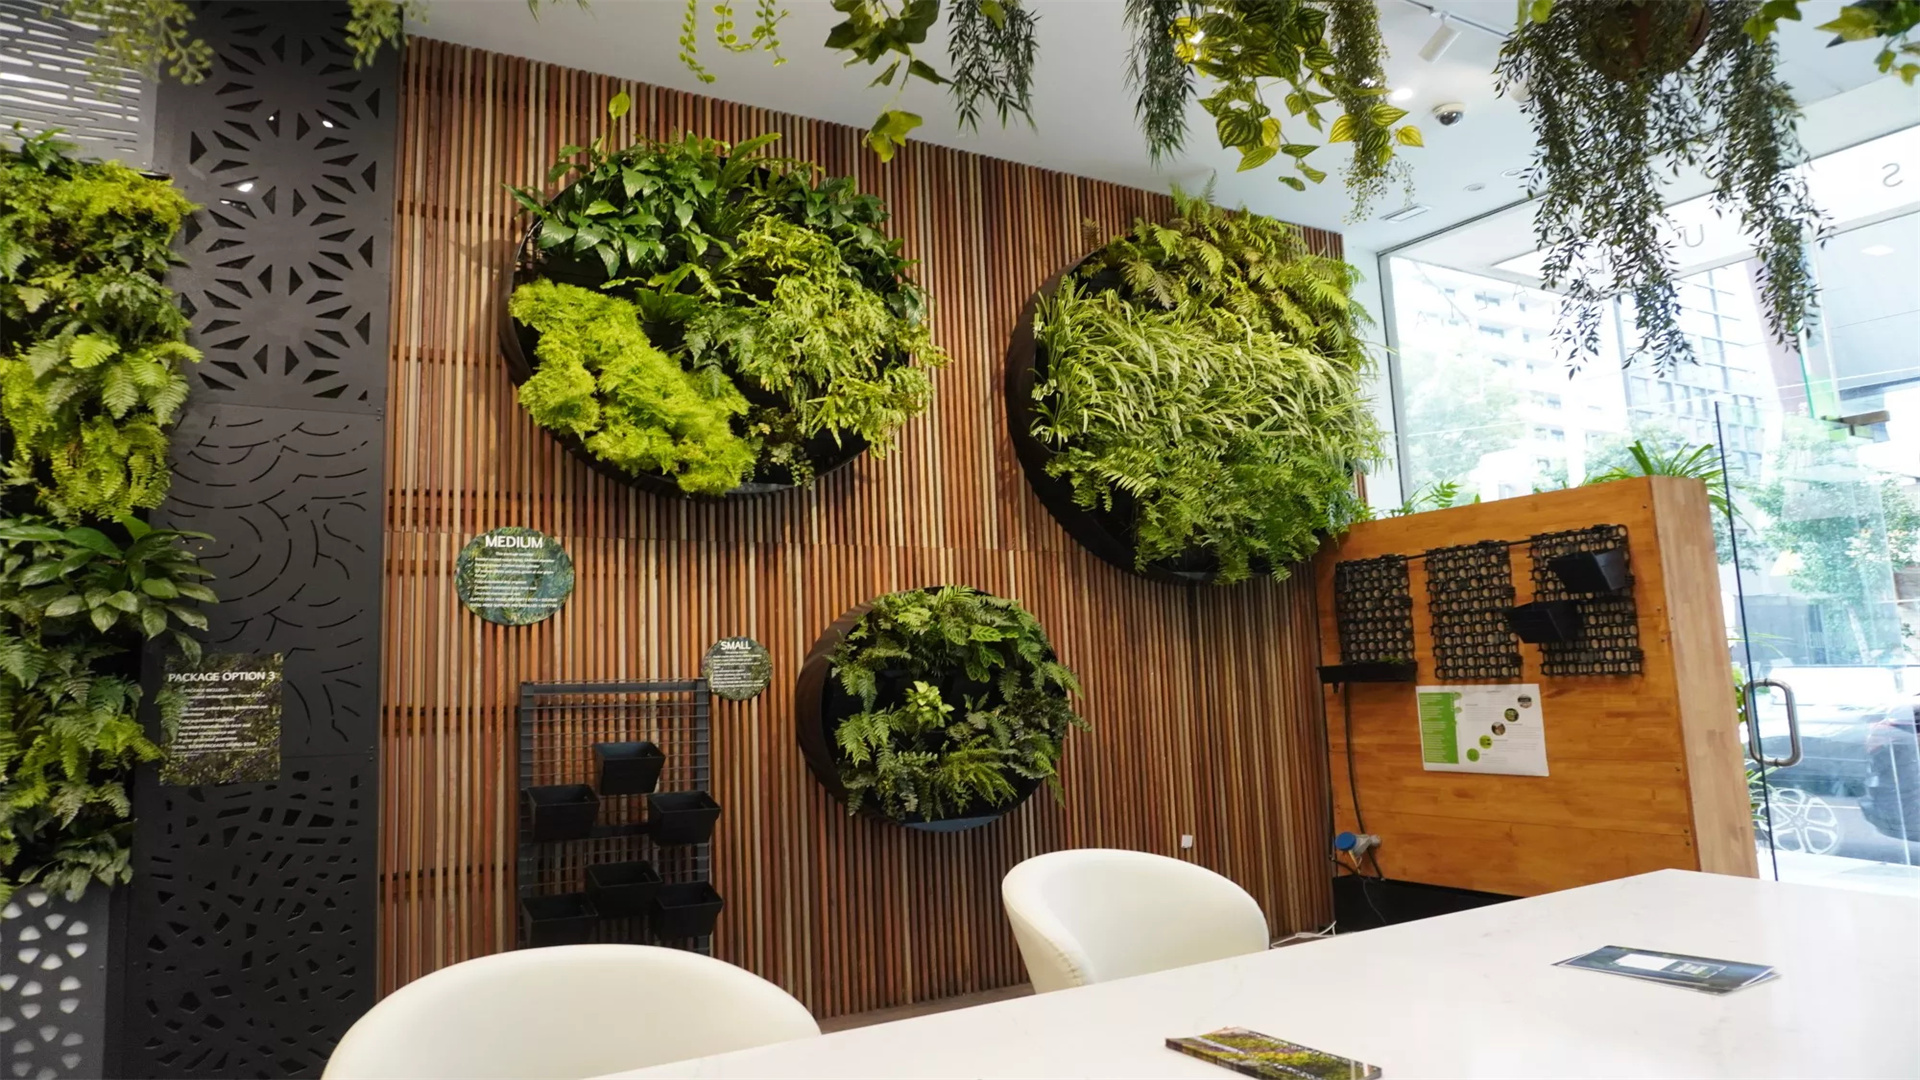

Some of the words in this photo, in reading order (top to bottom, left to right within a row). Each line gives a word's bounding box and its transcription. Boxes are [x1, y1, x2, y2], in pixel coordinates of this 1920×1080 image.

[484, 534, 544, 549] MEDIUM
[720, 640, 752, 651] SMALL
[168, 672, 220, 682] PACKAGE
[222, 671, 266, 682] OPTION
[267, 671, 276, 682] 3
